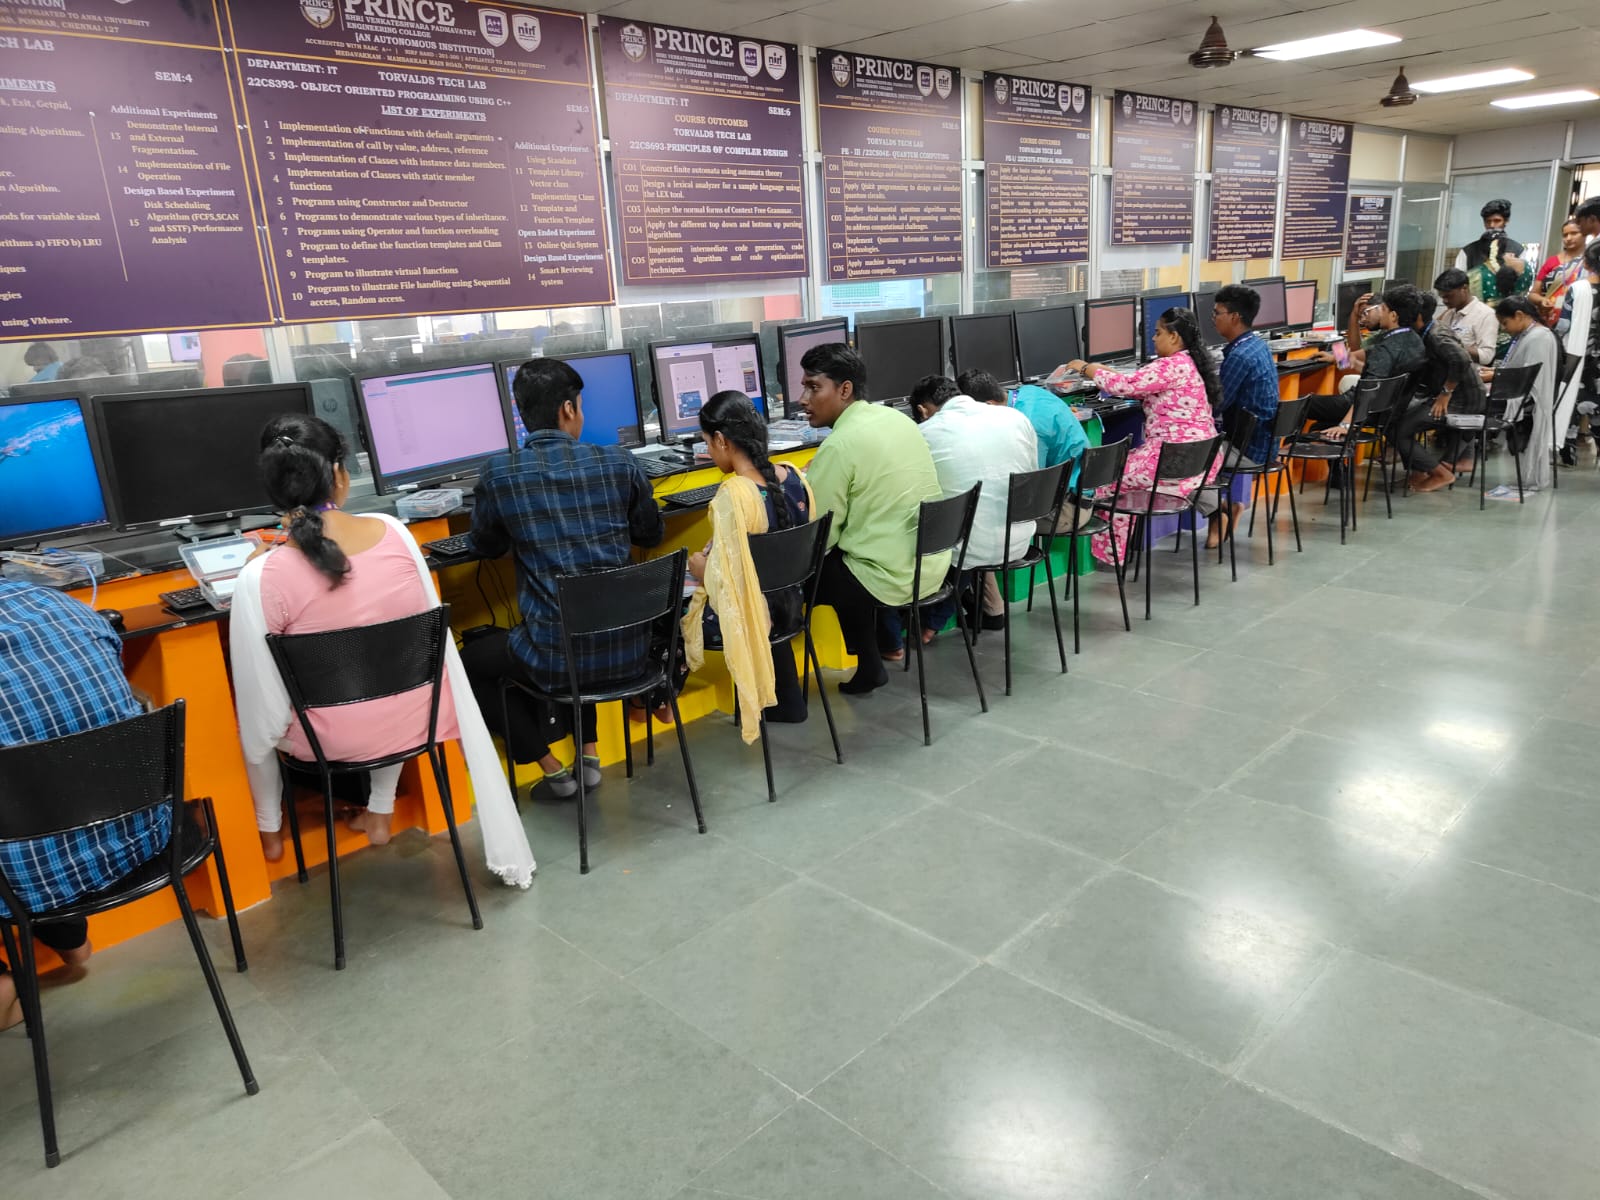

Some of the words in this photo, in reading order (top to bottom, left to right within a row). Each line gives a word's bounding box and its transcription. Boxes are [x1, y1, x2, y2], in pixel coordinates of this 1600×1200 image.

[344, 0, 456, 26] PRINCE
[399, 27, 431, 38] COLLEGE
[518, 23, 536, 35] nirf
[23, 38, 54, 51] LAB
[374, 36, 437, 49] AUTONOMOUS
[653, 27, 734, 58] PRINCE
[247, 58, 325, 74] DEPARTMENT:
[327, 66, 338, 75] IT
[855, 56, 913, 81] PRINCE
[155, 72, 192, 83] SEM:4
[378, 71, 435, 85] TORVALDS
[437, 77, 464, 87] TECH
[467, 80, 486, 90] LAB
[301, 82, 342, 94] OBJECT
[345, 86, 395, 97] ORIENTED
[398, 90, 466, 103] PROGRAMMING
[469, 97, 495, 106] USING
[1012, 78, 1056, 98] PRINCE
[615, 93, 678, 106] DEPARTMENT:
[680, 99, 689, 107] IT
[1136, 95, 1170, 112] PRINCE
[111, 104, 160, 117] Additional
[162, 108, 218, 120] Experiments
[381, 105, 403, 116] LIST
[405, 107, 420, 117] OF
[422, 108, 486, 121] EXPERIMENTS
[1232, 108, 1259, 122] PRINCE
[127, 120, 183, 131] Demonstrate
[184, 124, 218, 132] Internal
[674, 114, 705, 124] COURSE
[708, 117, 748, 127] OUTCOMES
[278, 121, 351, 135] Implementation
[407, 128, 424, 138] with
[425, 130, 453, 140] default
[455, 132, 494, 142] arguments
[674, 128, 713, 138] TORVALDS
[715, 130, 735, 140] TECH
[737, 132, 751, 141] LAB
[130, 133, 146, 142] and
[148, 134, 184, 143] External
[132, 146, 198, 156] Fragmentation.
[713, 145, 723, 154] OF
[725, 146, 761, 156] COMPILER
[763, 147, 788, 157] DESIGN
[136, 160, 204, 171] Implementation
[215, 163, 231, 171] File
[284, 152, 356, 164] Implementation
[358, 155, 367, 163] of
[369, 156, 398, 165] Classes
[400, 157, 418, 166] with
[420, 158, 452, 168] instance
[472, 160, 506, 169] members.
[138, 172, 181, 182] Operation
[9, 184, 60, 194] Algorithm.
[124, 186, 156, 197] Design
[158, 187, 184, 196] Based
[186, 188, 234, 198] Experiment
[144, 201, 163, 210] Disk
[165, 201, 211, 211] Scheduling
[292, 198, 335, 208] Programs
[337, 198, 360, 208] using
[362, 199, 411, 207] Constructor
[646, 206, 671, 214] Analyze
[20, 212, 35, 221] for
[36, 212, 75, 221] variable
[77, 213, 100, 221] sized
[147, 213, 190, 223] Algorithm
[295, 213, 337, 222] Programs
[350, 213, 402, 221] demonstrate
[435, 214, 455, 222] types
[297, 227, 340, 237] Programs
[342, 228, 365, 236] using
[367, 227, 403, 237] Operator
[456, 227, 499, 235] overloading
[560, 229, 596, 238] Experiment
[71, 239, 81, 248] b)
[152, 236, 186, 245] Analysis
[300, 242, 338, 252] Program
[351, 241, 378, 250] define
[430, 241, 466, 249] templates
[303, 255, 348, 265] templates.
[308, 285, 349, 295] Programs
[362, 283, 399, 291] illustrate
[416, 281, 451, 290] handling
[473, 278, 510, 287] Sequential
[342, 296, 376, 305] Random
[2, 318, 29, 327] using
